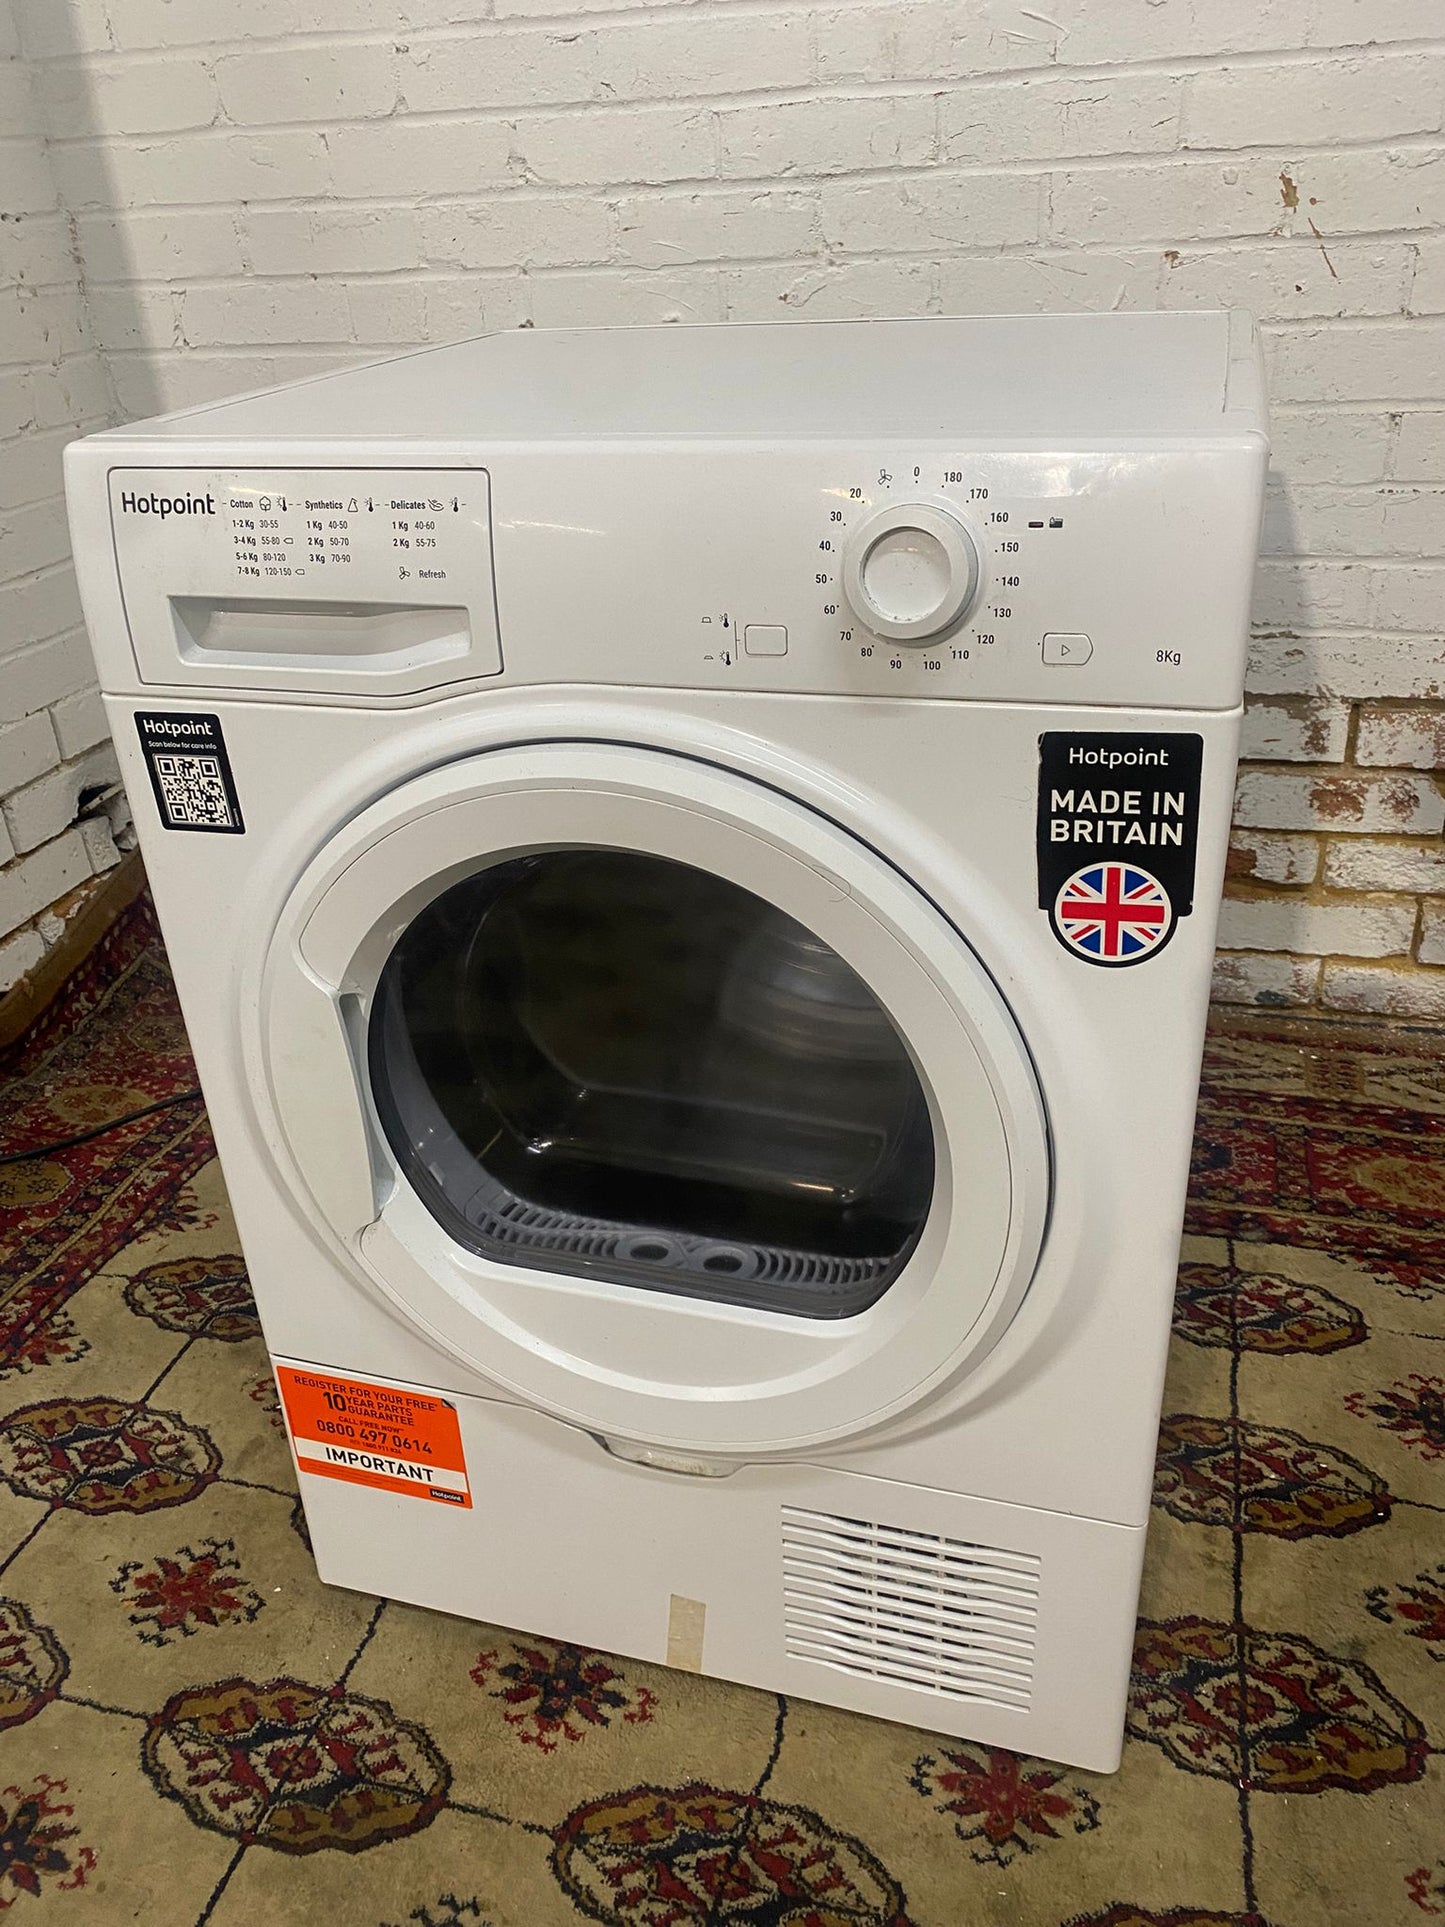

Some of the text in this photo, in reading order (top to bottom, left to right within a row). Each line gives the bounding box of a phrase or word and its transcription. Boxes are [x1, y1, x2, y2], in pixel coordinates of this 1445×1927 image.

[913, 467, 920, 477] 0
[943, 471, 963, 483] 180
[849, 488, 862, 499] 20
[969, 488, 989, 500] 170
[122, 492, 215, 520] Hotpoint
[230, 500, 253, 508] Cotton
[305, 500, 343, 511] Synthetics
[391, 501, 426, 510] Delicates
[830, 511, 842, 523] 30
[990, 512, 1009, 524] 160
[232, 520, 279, 530] 1-2 Kg 30-55
[306, 521, 347, 531] 1 Kg 40-50
[392, 521, 435, 531] 1 Kg 40-60
[234, 536, 280, 546] 3-4 Kg 55-80
[314, 538, 324, 547] Kg
[330, 538, 349, 546] 50-70
[393, 538, 436, 549] 2 Kg 55-75
[819, 540, 831, 552] 40
[1000, 542, 1019, 554] 150
[236, 552, 286, 562] 5-6 Kg 80-120
[309, 554, 351, 564] 3 Kg 70-90
[238, 567, 291, 577] 7-8 Kg 120-150
[419, 570, 446, 579] Refresh
[815, 573, 828, 584] 50
[1001, 575, 1020, 588] 140
[824, 604, 836, 615] 60
[993, 607, 1012, 619] 130
[840, 630, 852, 642] 70
[977, 633, 995, 645] 120
[861, 646, 873, 657] 80
[952, 649, 970, 661] 110
[1156, 649, 1182, 666] 8Kg
[890, 659, 902, 670] 90
[923, 660, 941, 672] 100
[143, 719, 213, 737] Hotpoint
[1070, 748, 1169, 769] Hotpoint
[1051, 789, 1185, 815] MADE IN
[1050, 819, 1183, 846] BRITAIN
[294, 1376, 346, 1393] REGISTER
[350, 1387, 371, 1398] FOR
[373, 1391, 403, 1405] YOUR
[323, 1392, 413, 1416] 10 YEAR PARTS
[348, 1406, 414, 1426] GUARANTEE
[339, 1416, 358, 1425] CALL
[360, 1420, 379, 1429] FREE
[317, 1420, 432, 1454] 0800 497 0614
[326, 1447, 434, 1482] IMPORTANT
[432, 1490, 462, 1502] Hotpoint
